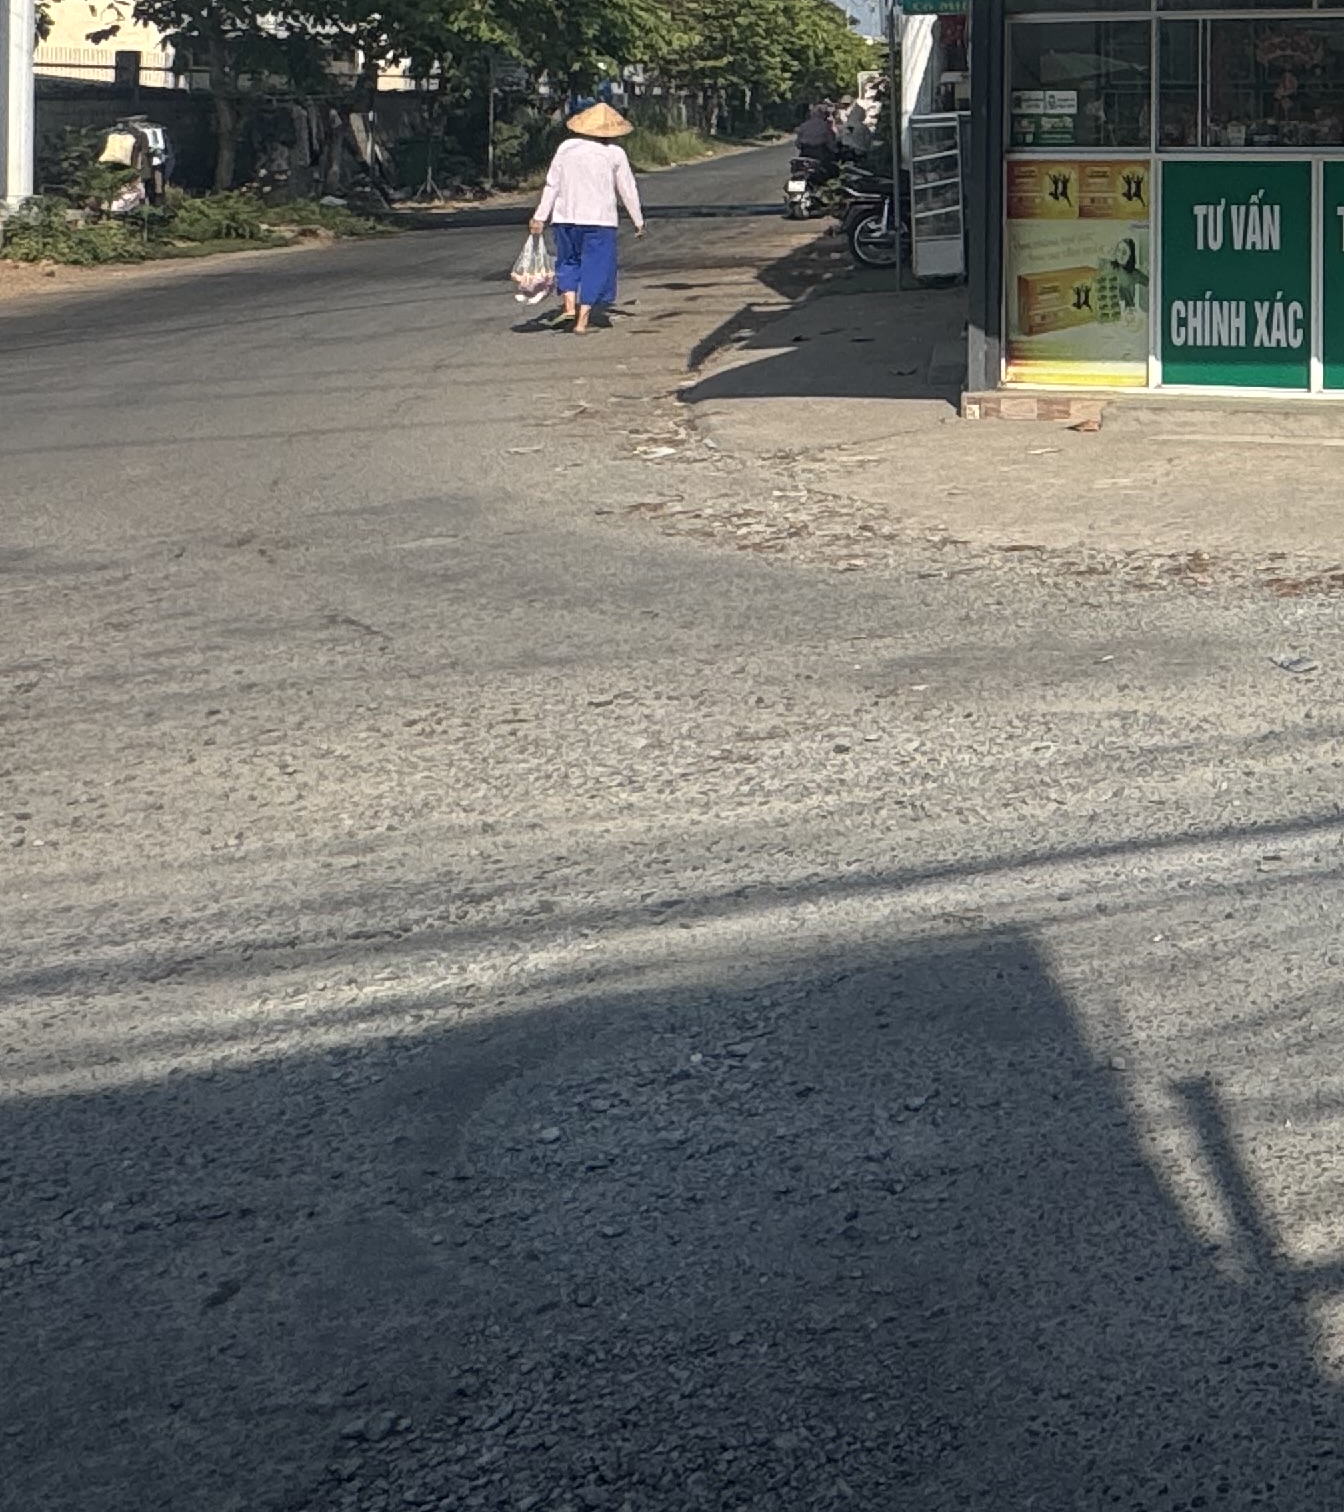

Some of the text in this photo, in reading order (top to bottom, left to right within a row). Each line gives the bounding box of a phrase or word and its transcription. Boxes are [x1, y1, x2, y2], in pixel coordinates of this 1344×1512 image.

[1193, 188, 1281, 251] TƯ VẤN
[1170, 290, 1304, 348] CHÍNH XÁC
